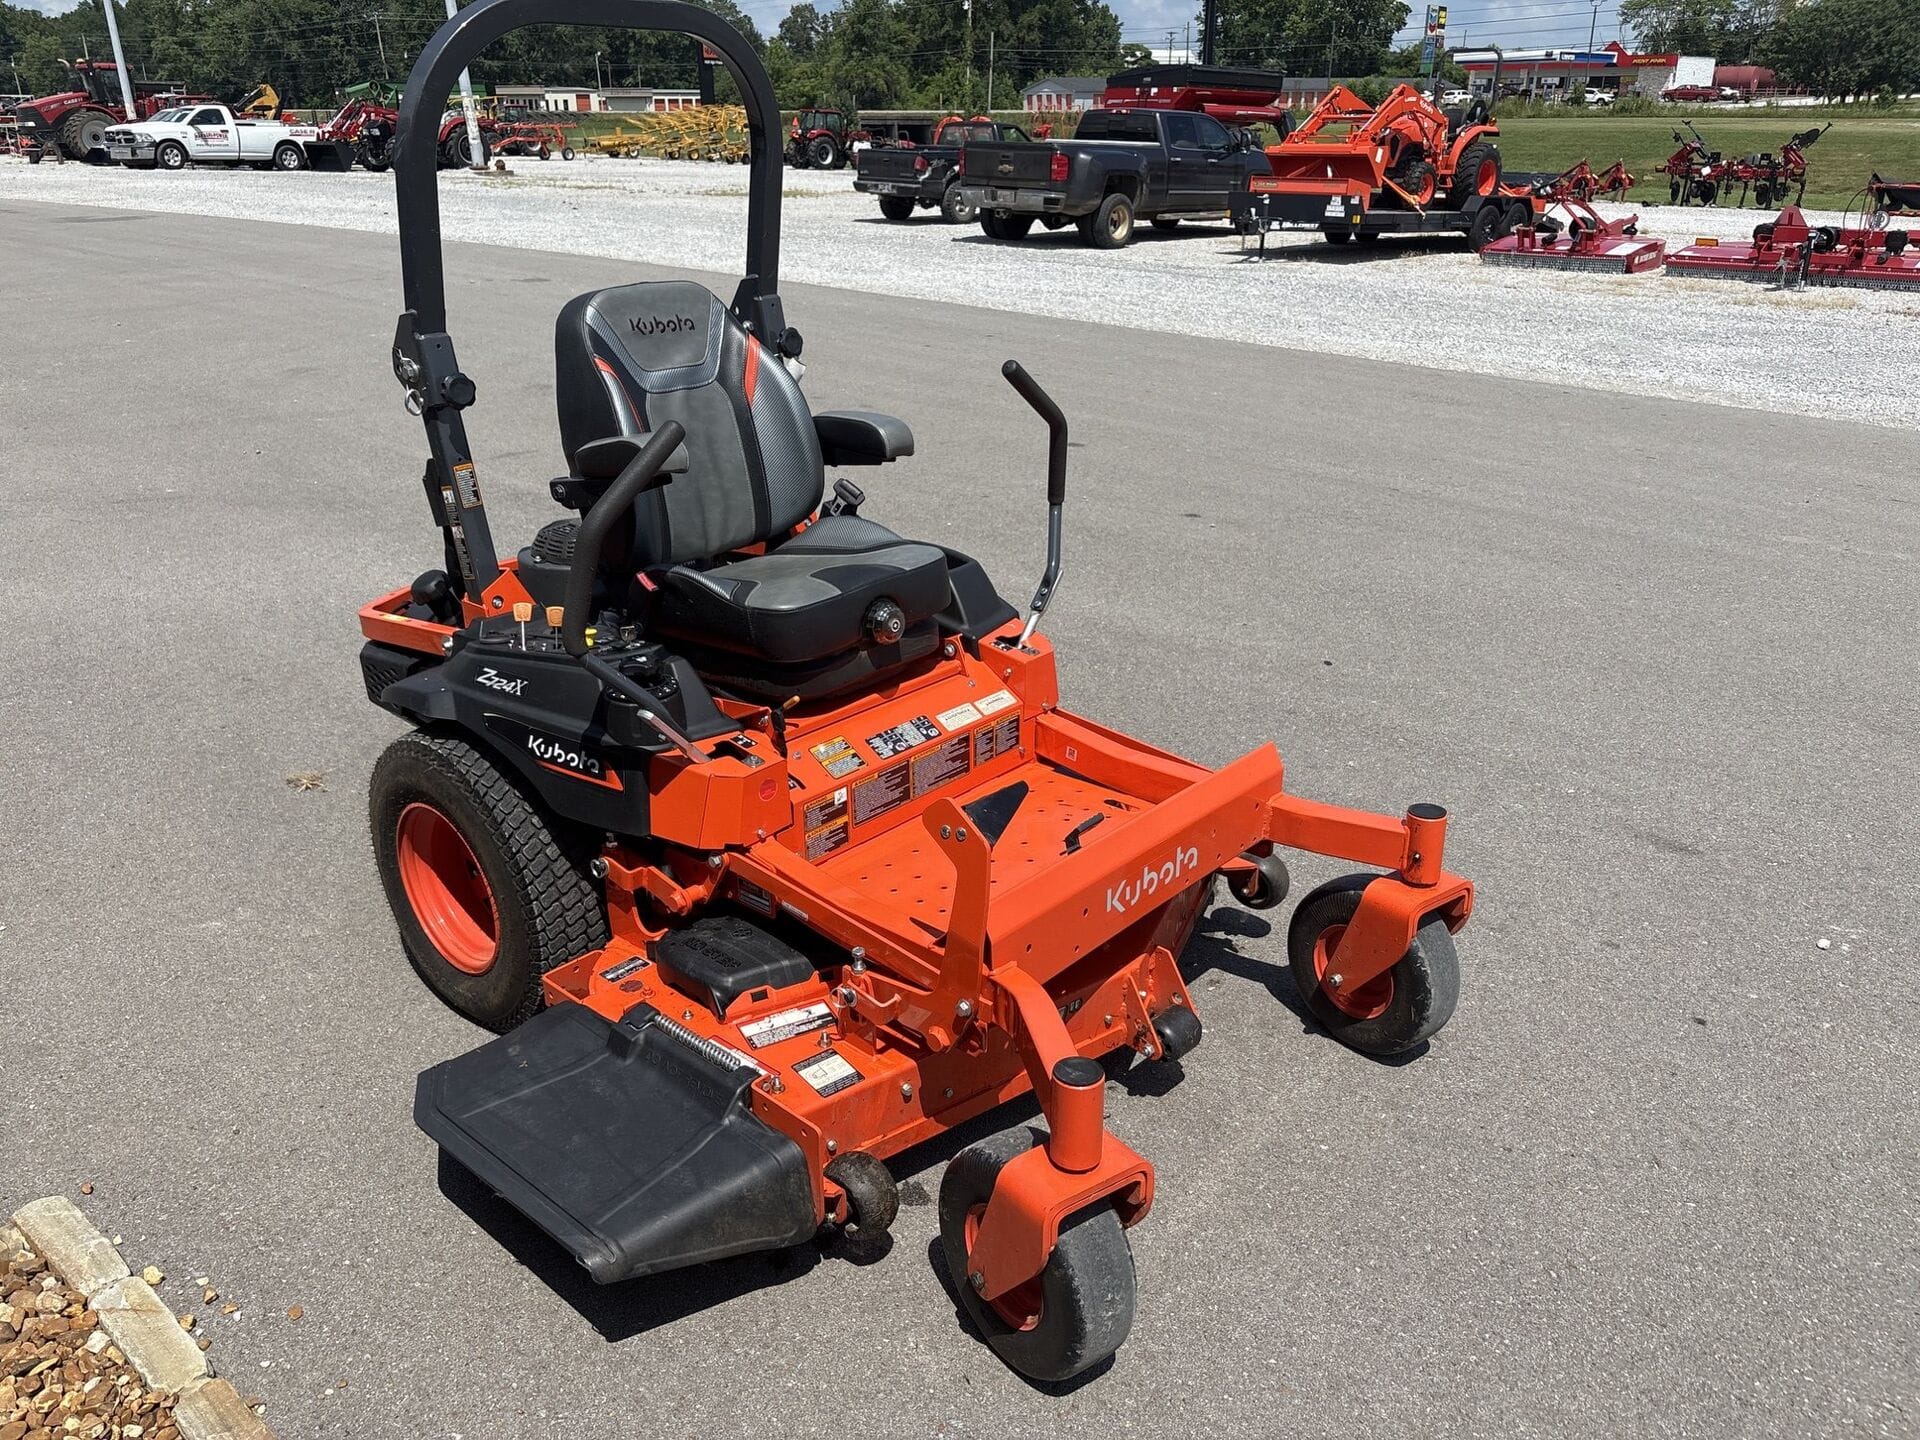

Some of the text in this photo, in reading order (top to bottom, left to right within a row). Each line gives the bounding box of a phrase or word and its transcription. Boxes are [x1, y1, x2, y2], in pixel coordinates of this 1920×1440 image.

[628, 313, 696, 336] Kubota
[476, 667, 529, 696] Z724X
[527, 734, 600, 774] Kubota
[1106, 846, 1198, 913] Kubota
